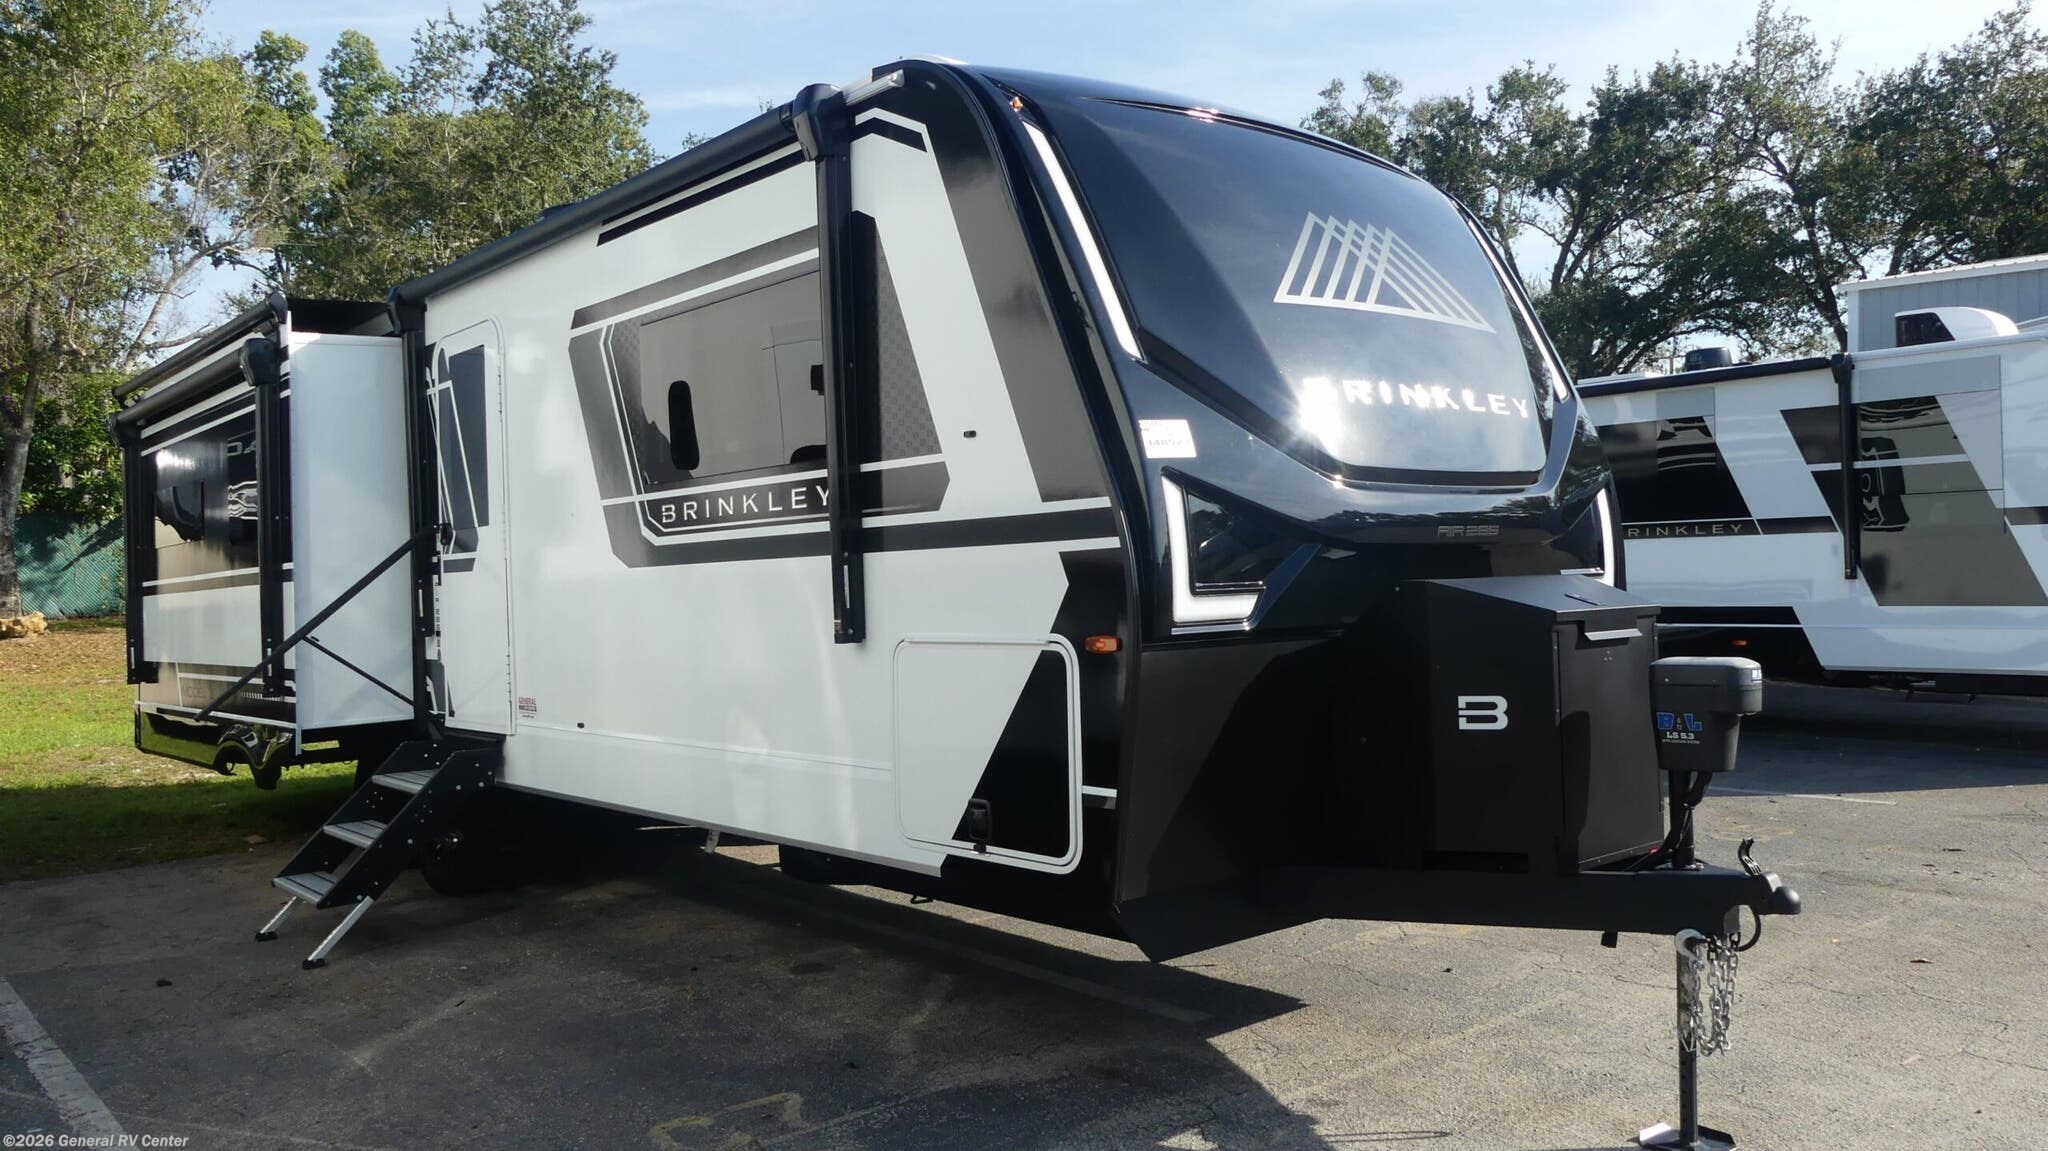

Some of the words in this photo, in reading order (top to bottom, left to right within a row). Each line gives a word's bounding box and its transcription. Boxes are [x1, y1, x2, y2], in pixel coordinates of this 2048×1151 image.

[1302, 377, 1529, 419] RINKLEY
[661, 484, 829, 523] BRINKLEY
[1627, 524, 1743, 537] RINKLEY
